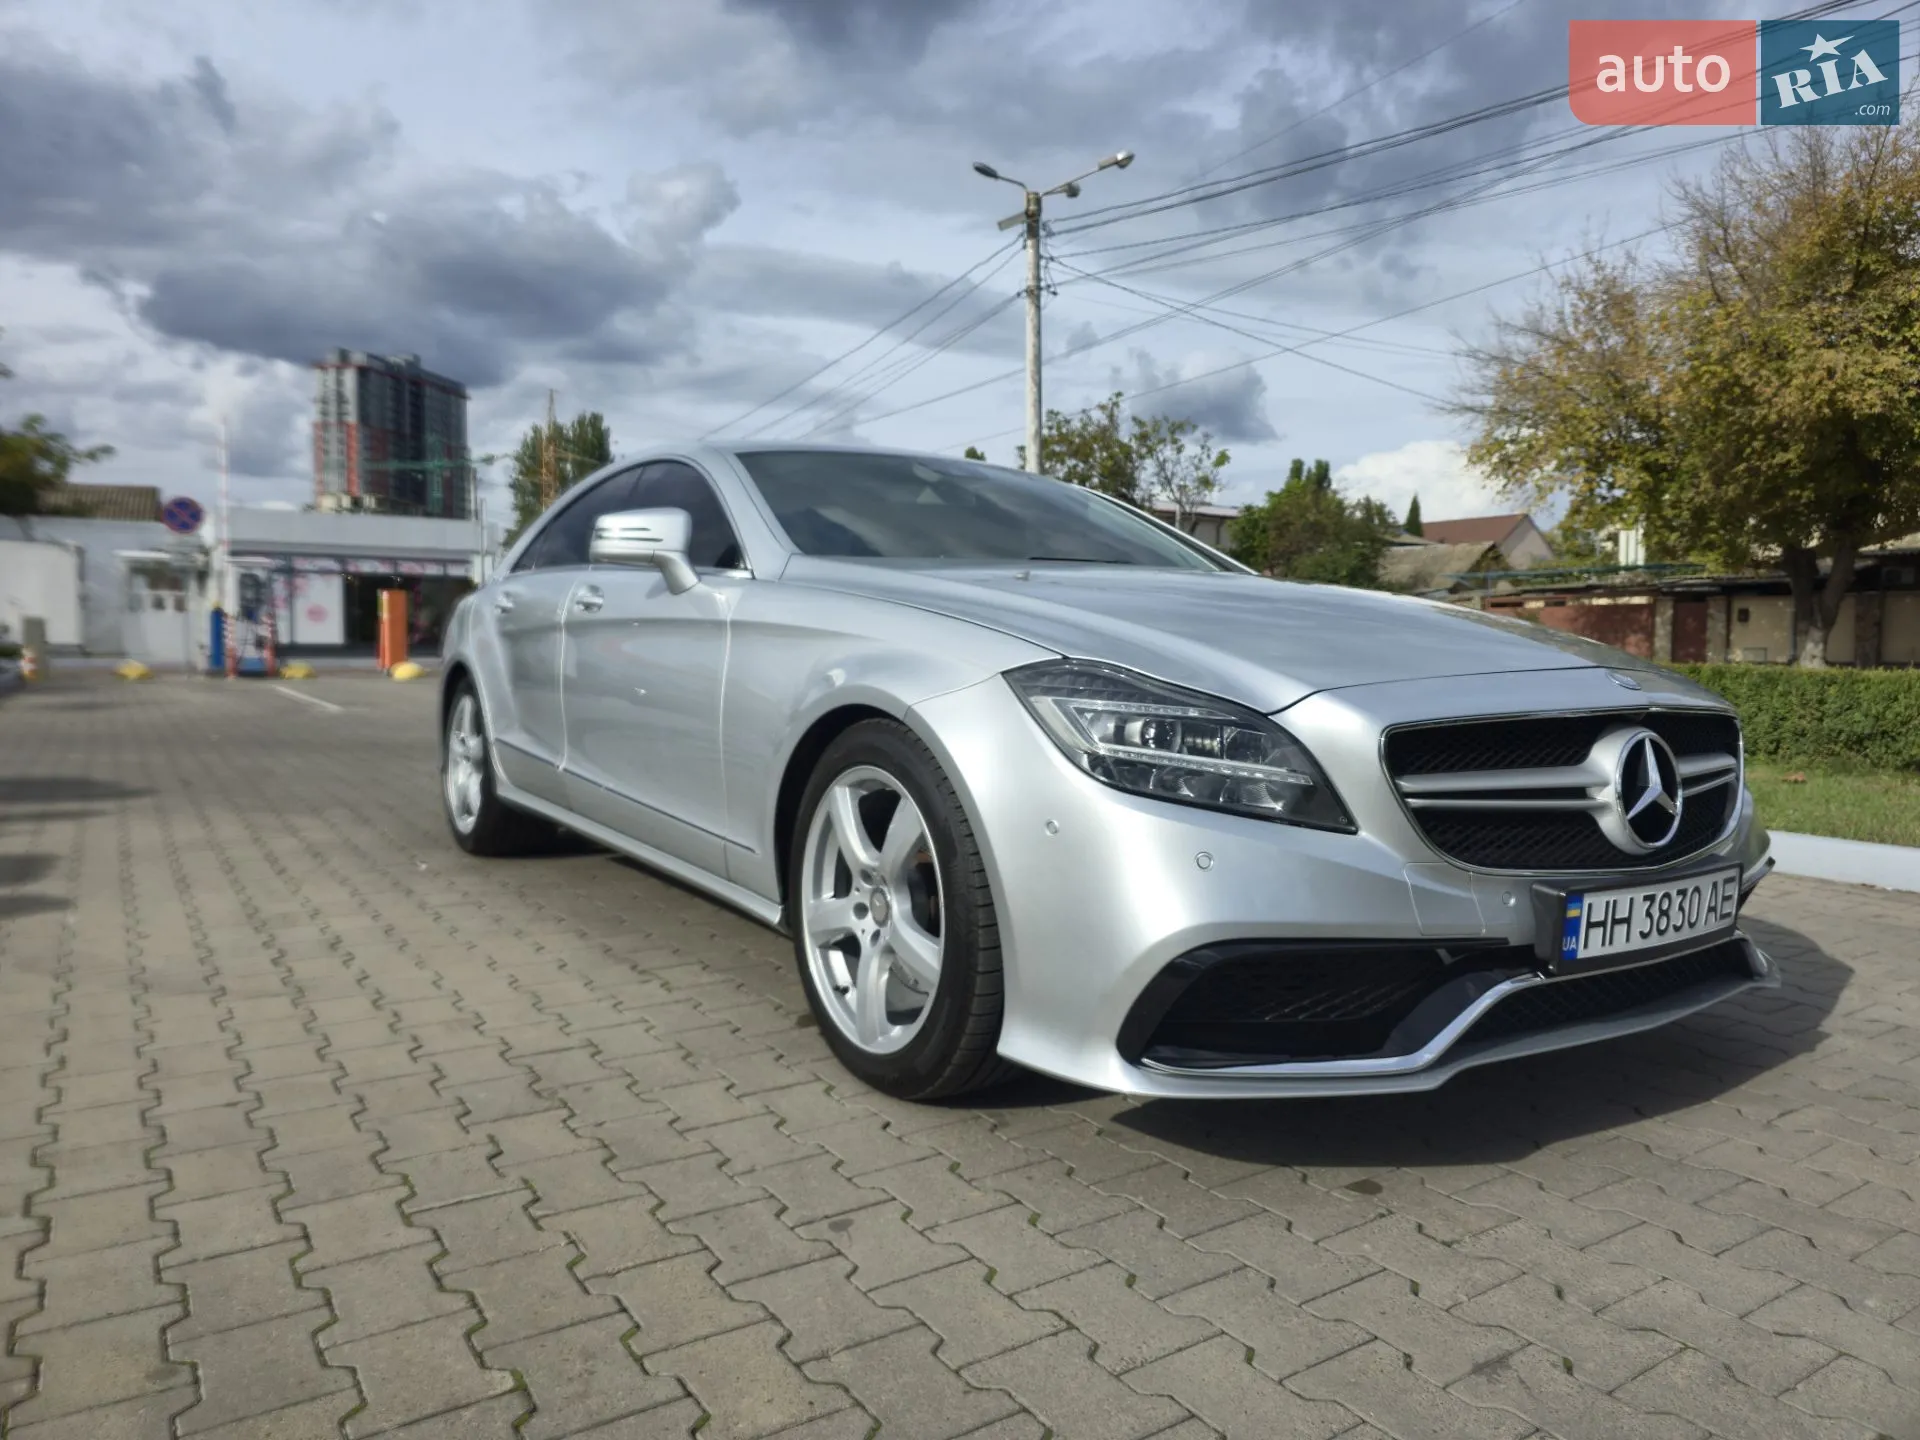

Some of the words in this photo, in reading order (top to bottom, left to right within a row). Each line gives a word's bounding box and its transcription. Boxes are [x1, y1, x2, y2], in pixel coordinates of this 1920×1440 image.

[1582, 897, 1634, 949] HH
[1639, 886, 1702, 939] 3830
[1704, 876, 1736, 926] AE
[1562, 937, 1577, 951] UA
